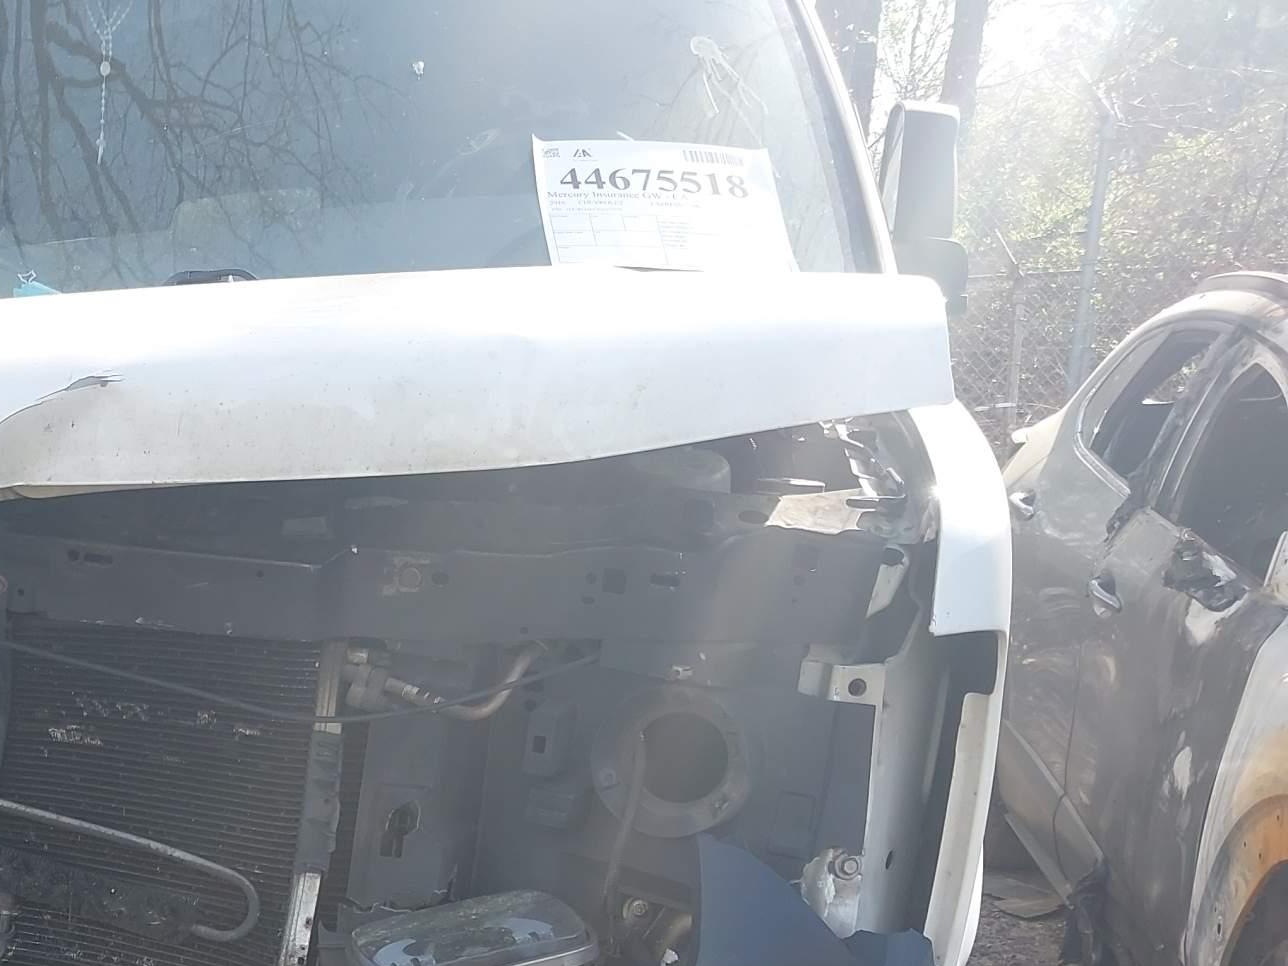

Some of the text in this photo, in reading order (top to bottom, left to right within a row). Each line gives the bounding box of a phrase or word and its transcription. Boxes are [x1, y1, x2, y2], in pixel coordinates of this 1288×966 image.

[559, 167, 749, 199] 44675518
[546, 190, 589, 199] Mercury
[591, 190, 639, 199] Insurance
